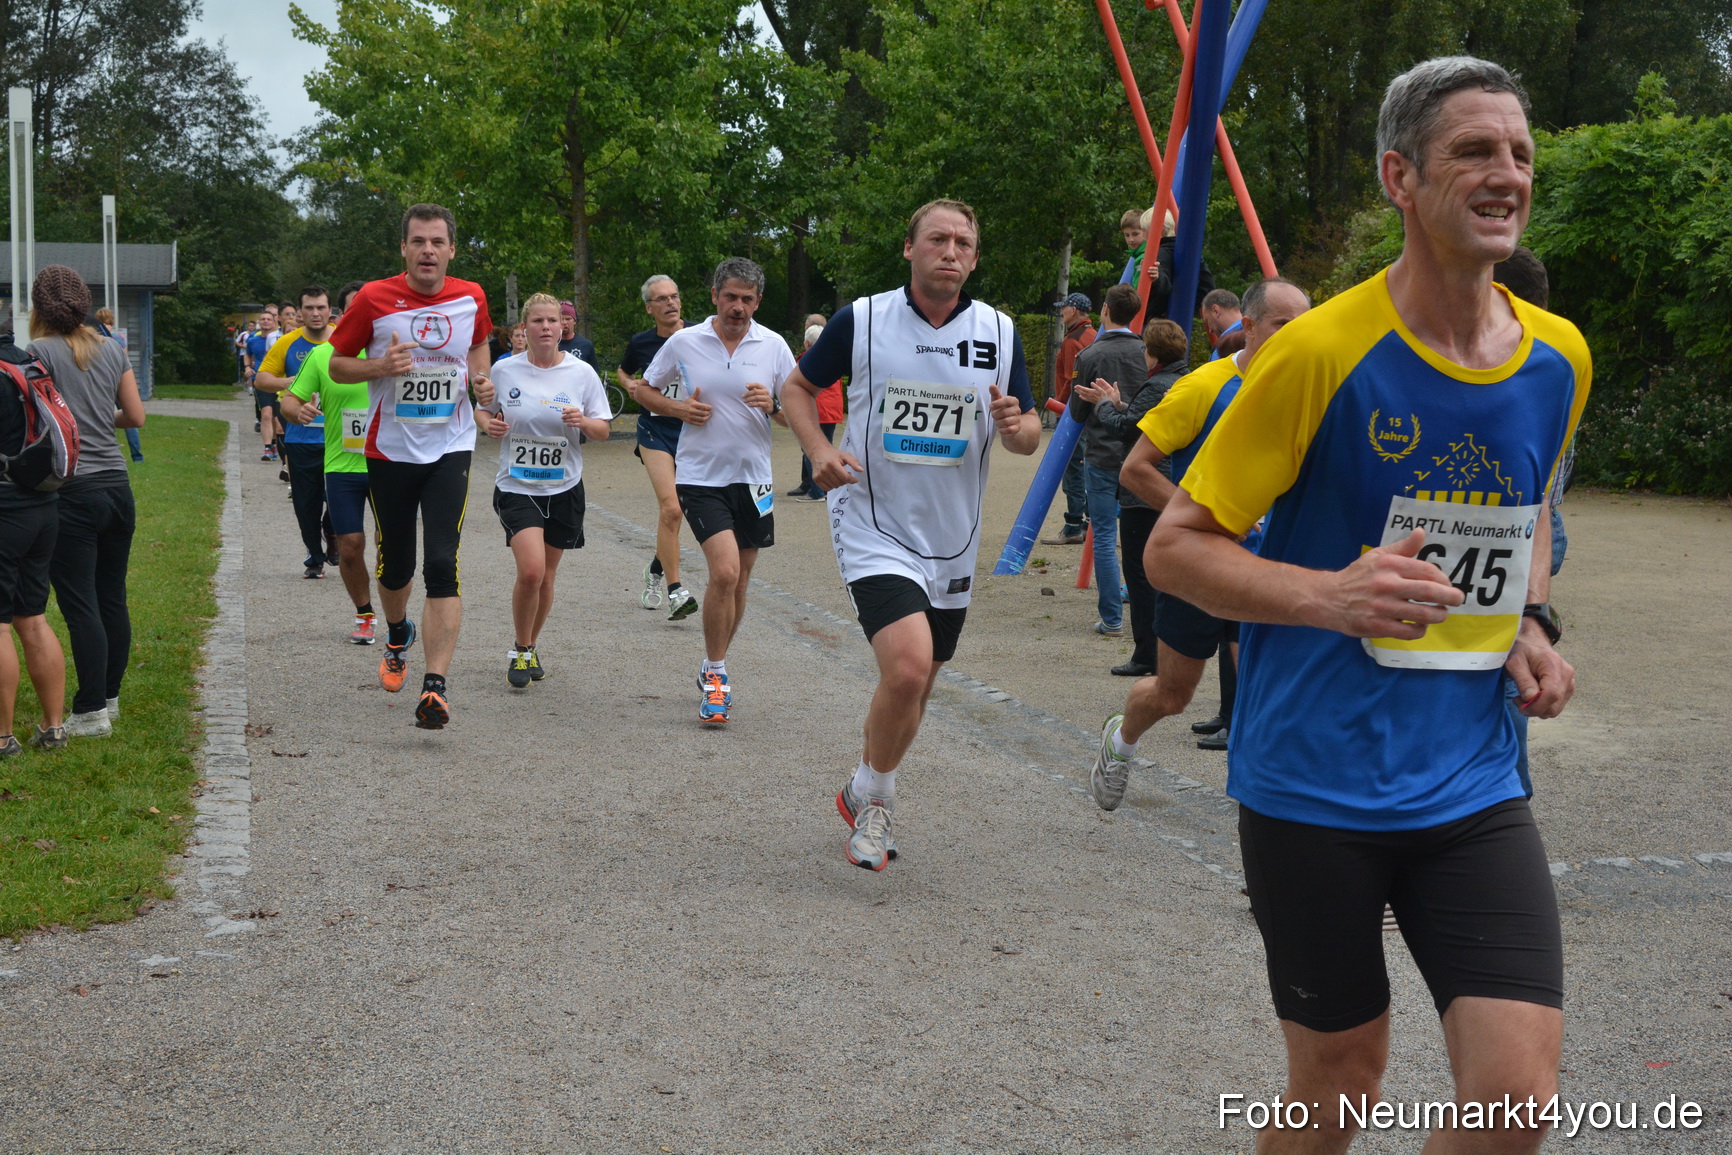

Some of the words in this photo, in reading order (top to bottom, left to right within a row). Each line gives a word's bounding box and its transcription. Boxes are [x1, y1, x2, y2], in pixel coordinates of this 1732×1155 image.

[916, 345, 954, 357] SPALDING
[957, 340, 997, 370] 13
[402, 380, 452, 402] 2901
[888, 386, 918, 397] PARTL
[920, 390, 962, 402] Neumarkt
[418, 406, 436, 416] Willi
[892, 400, 964, 434] 2571
[1388, 416, 1402, 428] 15
[1378, 430, 1410, 443] Jahre
[900, 438, 951, 454] Christian
[516, 446, 562, 466] 2168
[524, 470, 551, 478] Claudia
[1390, 514, 1447, 534] PARTL
[1451, 520, 1522, 539] Neumarkt
